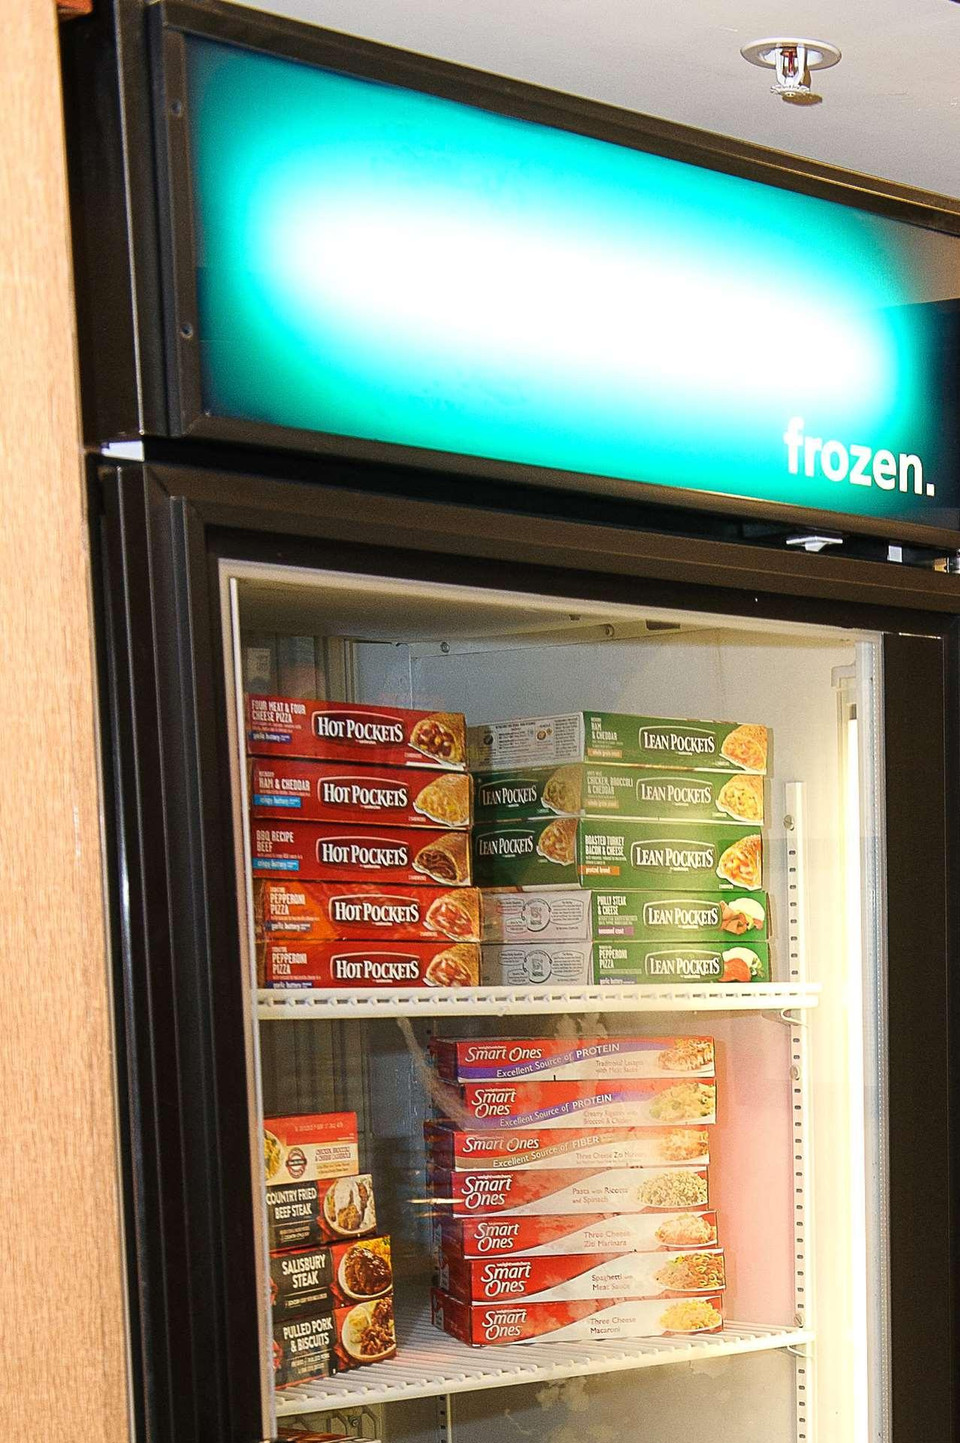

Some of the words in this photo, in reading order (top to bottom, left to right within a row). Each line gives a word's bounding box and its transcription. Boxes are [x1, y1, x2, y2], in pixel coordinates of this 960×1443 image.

[784, 416, 937, 497] frozen.
[252, 711, 275, 722] CHEESE
[276, 712, 293, 723] PIZZA
[318, 716, 344, 738] HOT
[346, 720, 403, 743] POCKETS
[644, 732, 670, 750] LEAN
[670, 734, 715, 753] POCKETS
[259, 777, 274, 790] HAM
[282, 778, 310, 792] CHEDDAR
[324, 784, 350, 802] HOT
[352, 785, 408, 807] POCKETS
[482, 790, 500, 806] LEAN
[502, 786, 538, 804] POCKETS
[640, 784, 667, 800] LEAN
[667, 785, 712, 804] POCKETS
[256, 830, 270, 841] BBQ
[271, 830, 294, 843] RECIPE
[585, 835, 606, 846] ROASTED
[607, 836, 625, 847] TURKEY
[256, 842, 273, 852] BEEF
[322, 842, 348, 862] HOT
[350, 844, 408, 866] POCKETS
[479, 839, 499, 856] LEAN
[500, 836, 533, 854] POCKETS
[636, 846, 664, 866] LEAN
[665, 848, 714, 868] POCKETS
[270, 893, 306, 905] PEPPERONI
[597, 896, 611, 906] PHILLY
[612, 896, 627, 906] STEAK
[270, 904, 290, 915] PIZZA
[334, 902, 362, 920] HOT
[364, 904, 420, 924] POCKETS
[648, 907, 675, 924] LEAN
[676, 908, 718, 928] POCKETS
[272, 953, 307, 964] PEPPERONI
[599, 949, 628, 959] PEPPERONI
[273, 964, 291, 975] PIZZA
[336, 960, 364, 978] HOT
[365, 961, 420, 981] POCKETS
[600, 959, 614, 968] PIZZA
[650, 958, 677, 974] LEAN
[677, 958, 720, 978] POCKETS
[465, 1046, 506, 1062] Smart
[509, 1047, 542, 1062] Ones
[496, 1065, 533, 1078] Excellent
[535, 1056, 562, 1071] Source
[564, 1052, 572, 1063] of
[576, 1044, 620, 1058] PROTEIN
[471, 1089, 517, 1106] Smart
[475, 1103, 510, 1118] Ones
[500, 1115, 533, 1127] Excellent
[535, 1107, 559, 1120] Source
[561, 1103, 570, 1112] of
[572, 1094, 612, 1110] PROTEIN
[462, 1137, 504, 1153] Smart
[506, 1137, 539, 1152] Ones
[493, 1156, 530, 1168] Excellent
[531, 1148, 558, 1161] Source
[560, 1144, 568, 1153] of
[572, 1136, 599, 1149] FIBER
[461, 1176, 512, 1194] Smart
[266, 1190, 298, 1205] COUNTRY
[298, 1188, 317, 1201] FRIED
[465, 1192, 505, 1209] Ones
[274, 1205, 291, 1220] BEEF
[291, 1203, 313, 1217] STEAK
[474, 1222, 520, 1240] Smart
[477, 1236, 514, 1252] Ones
[282, 1254, 326, 1275] SALISBURY
[481, 1264, 531, 1282] Smart
[292, 1270, 319, 1288] STEAK
[484, 1278, 525, 1297] Ones
[482, 1310, 527, 1328] Smart
[283, 1322, 311, 1340] PULLED
[312, 1317, 333, 1332] PORK
[485, 1324, 522, 1341] Ones
[290, 1340, 297, 1352] &
[297, 1333, 330, 1350] BISCUITS
